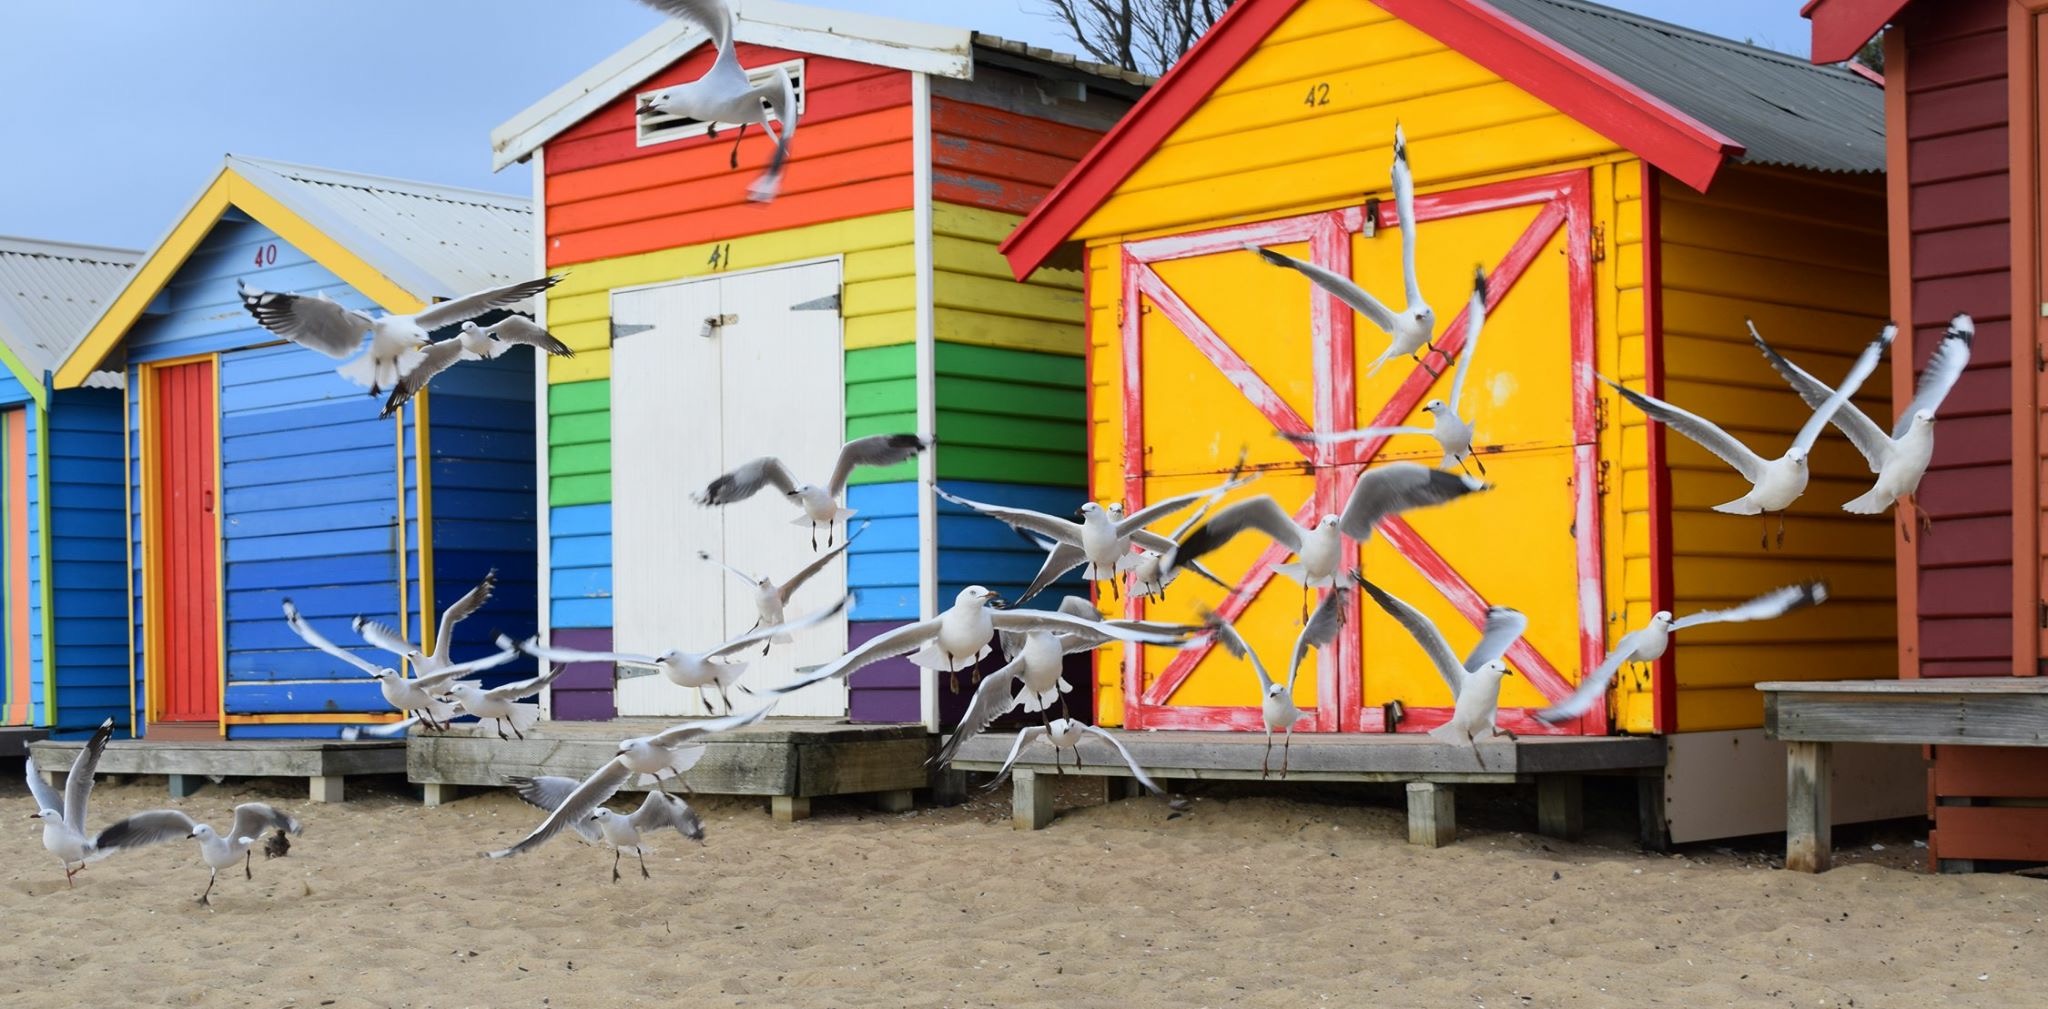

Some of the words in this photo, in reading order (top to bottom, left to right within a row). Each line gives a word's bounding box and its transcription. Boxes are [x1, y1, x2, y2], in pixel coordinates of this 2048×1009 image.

[1304, 82, 1330, 107] 42
[255, 244, 277, 267] 40
[707, 243, 730, 269] 41
